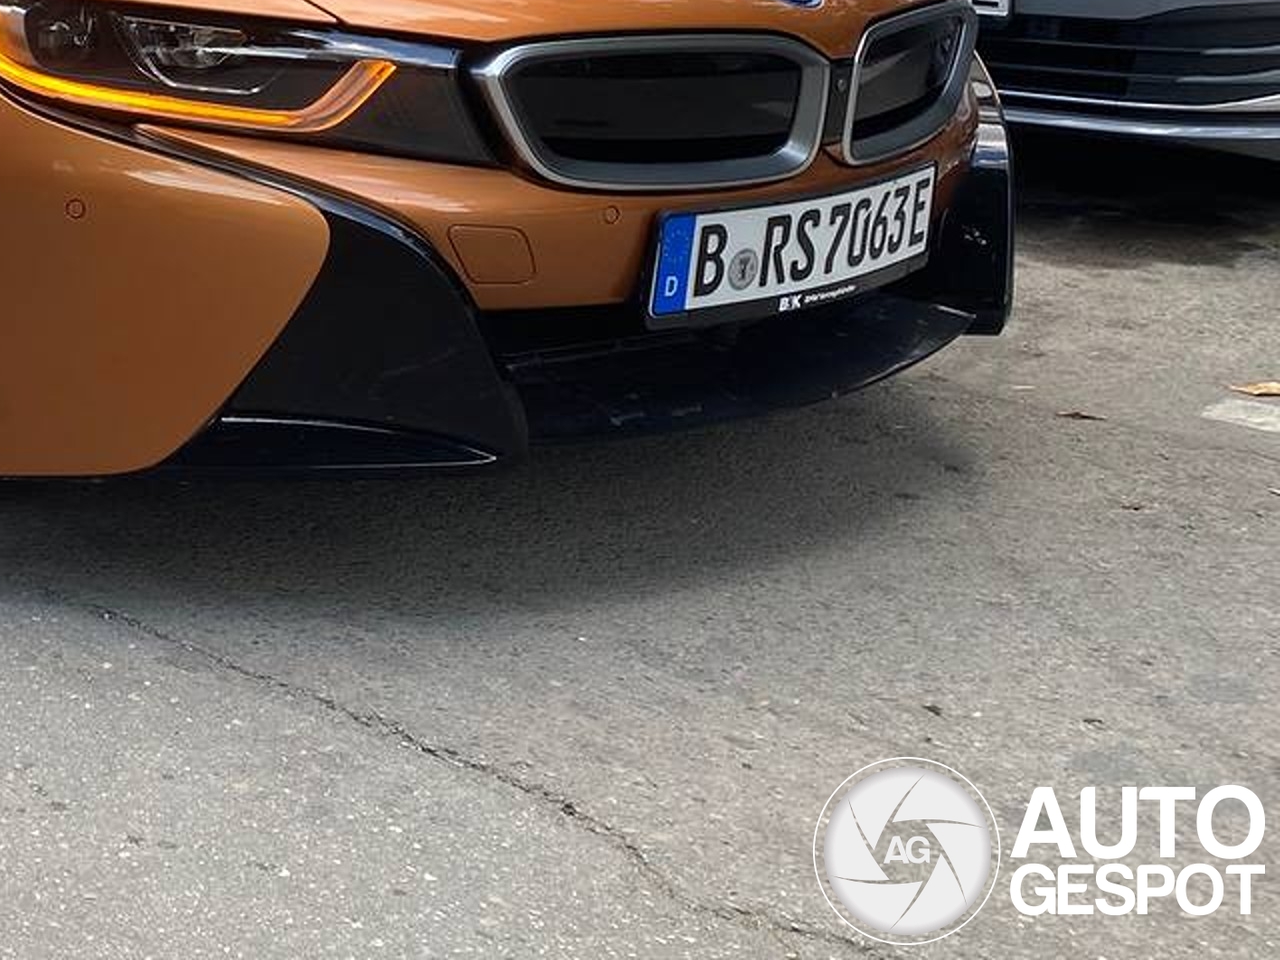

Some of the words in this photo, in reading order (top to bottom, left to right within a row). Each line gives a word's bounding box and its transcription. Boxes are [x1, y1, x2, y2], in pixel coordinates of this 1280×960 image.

[693, 223, 729, 298] B
[758, 208, 821, 288] RS
[823, 176, 931, 275] 7063E
[664, 275, 679, 297] D
